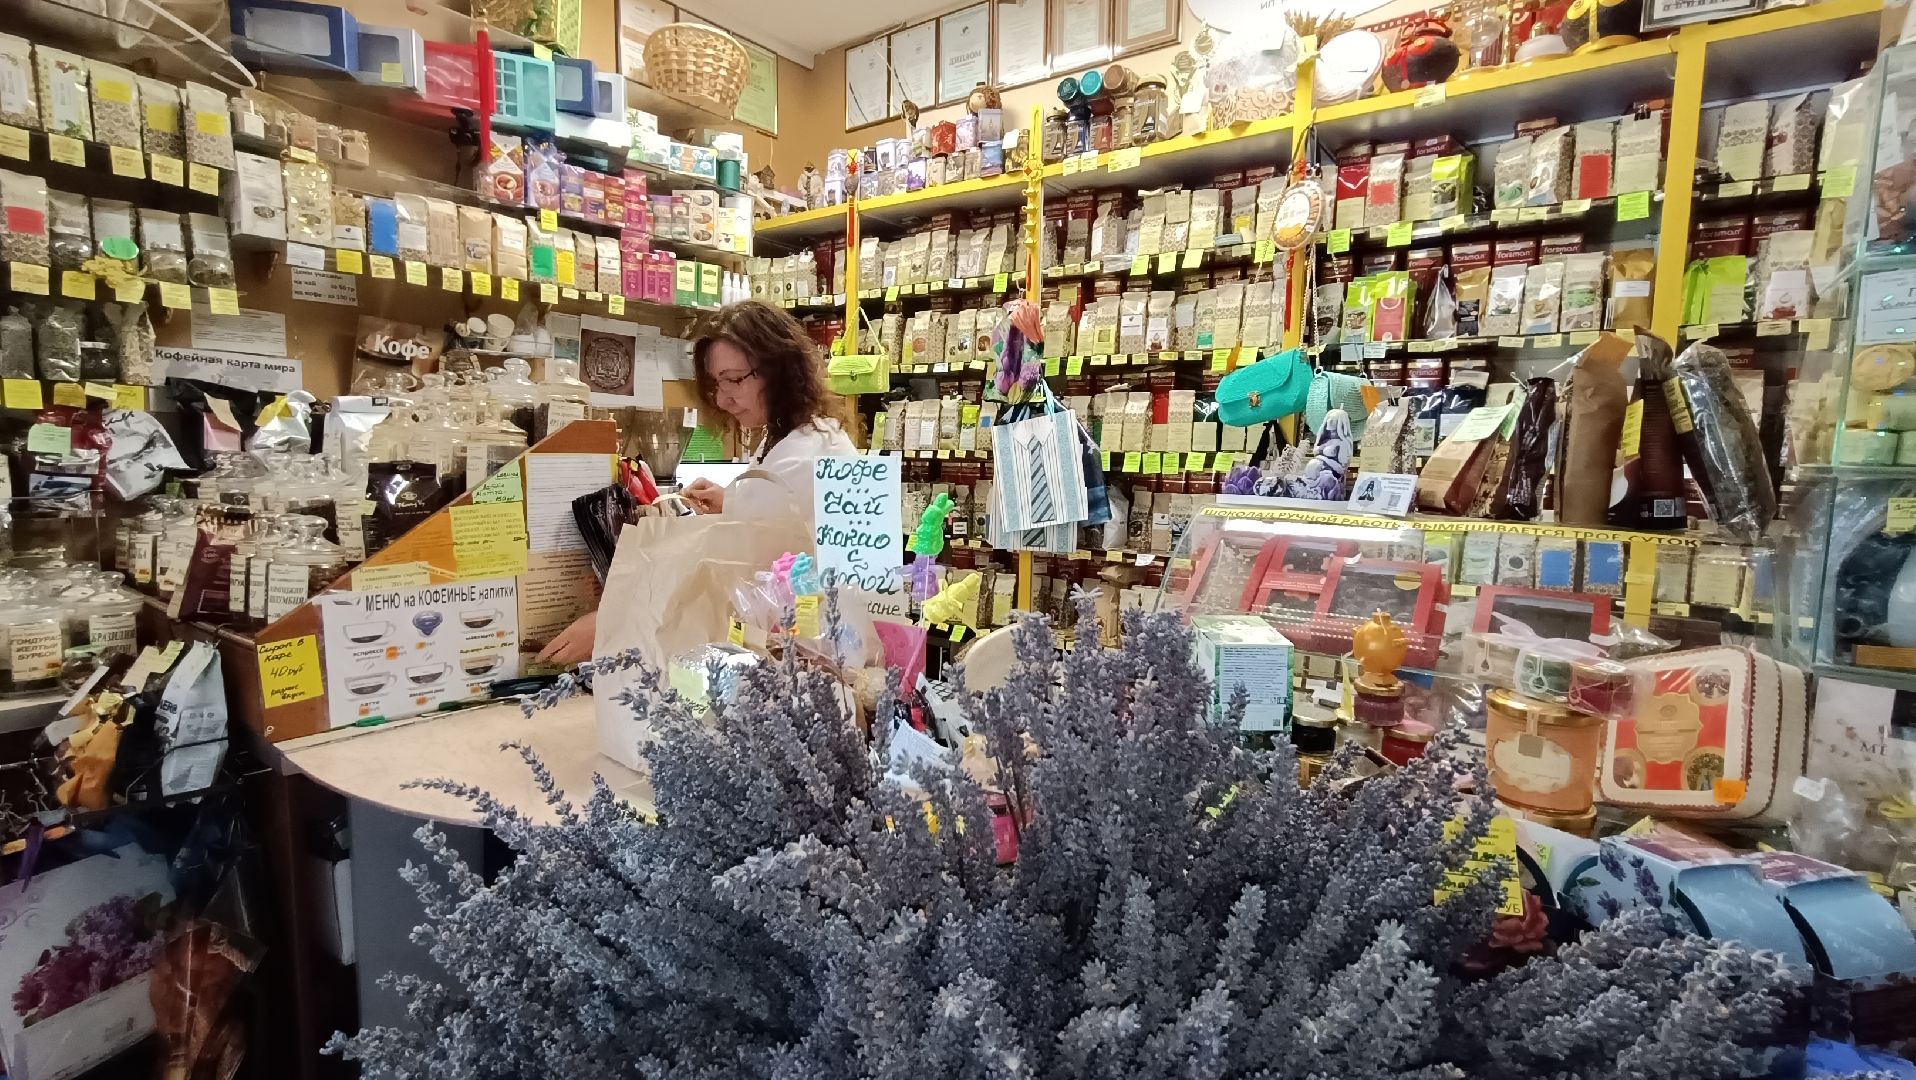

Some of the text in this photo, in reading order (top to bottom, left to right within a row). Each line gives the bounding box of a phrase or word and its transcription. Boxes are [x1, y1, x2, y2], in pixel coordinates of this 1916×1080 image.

[1497, 250, 1533, 260] forsman
[1544, 245, 1579, 254] forsman
[374, 334, 431, 361] Кофе
[155, 349, 297, 374] Кофейная карта мира
[816, 458, 889, 485] Кофе
[824, 490, 889, 516] Чай
[1204, 508, 1275, 519] ШОКОЛАД
[1278, 511, 1339, 525] РУЧНОЙ
[816, 524, 891, 550] Какао
[365, 592, 401, 612] МЕНЮ
[404, 595, 416, 608] на
[478, 584, 515, 601] напитки
